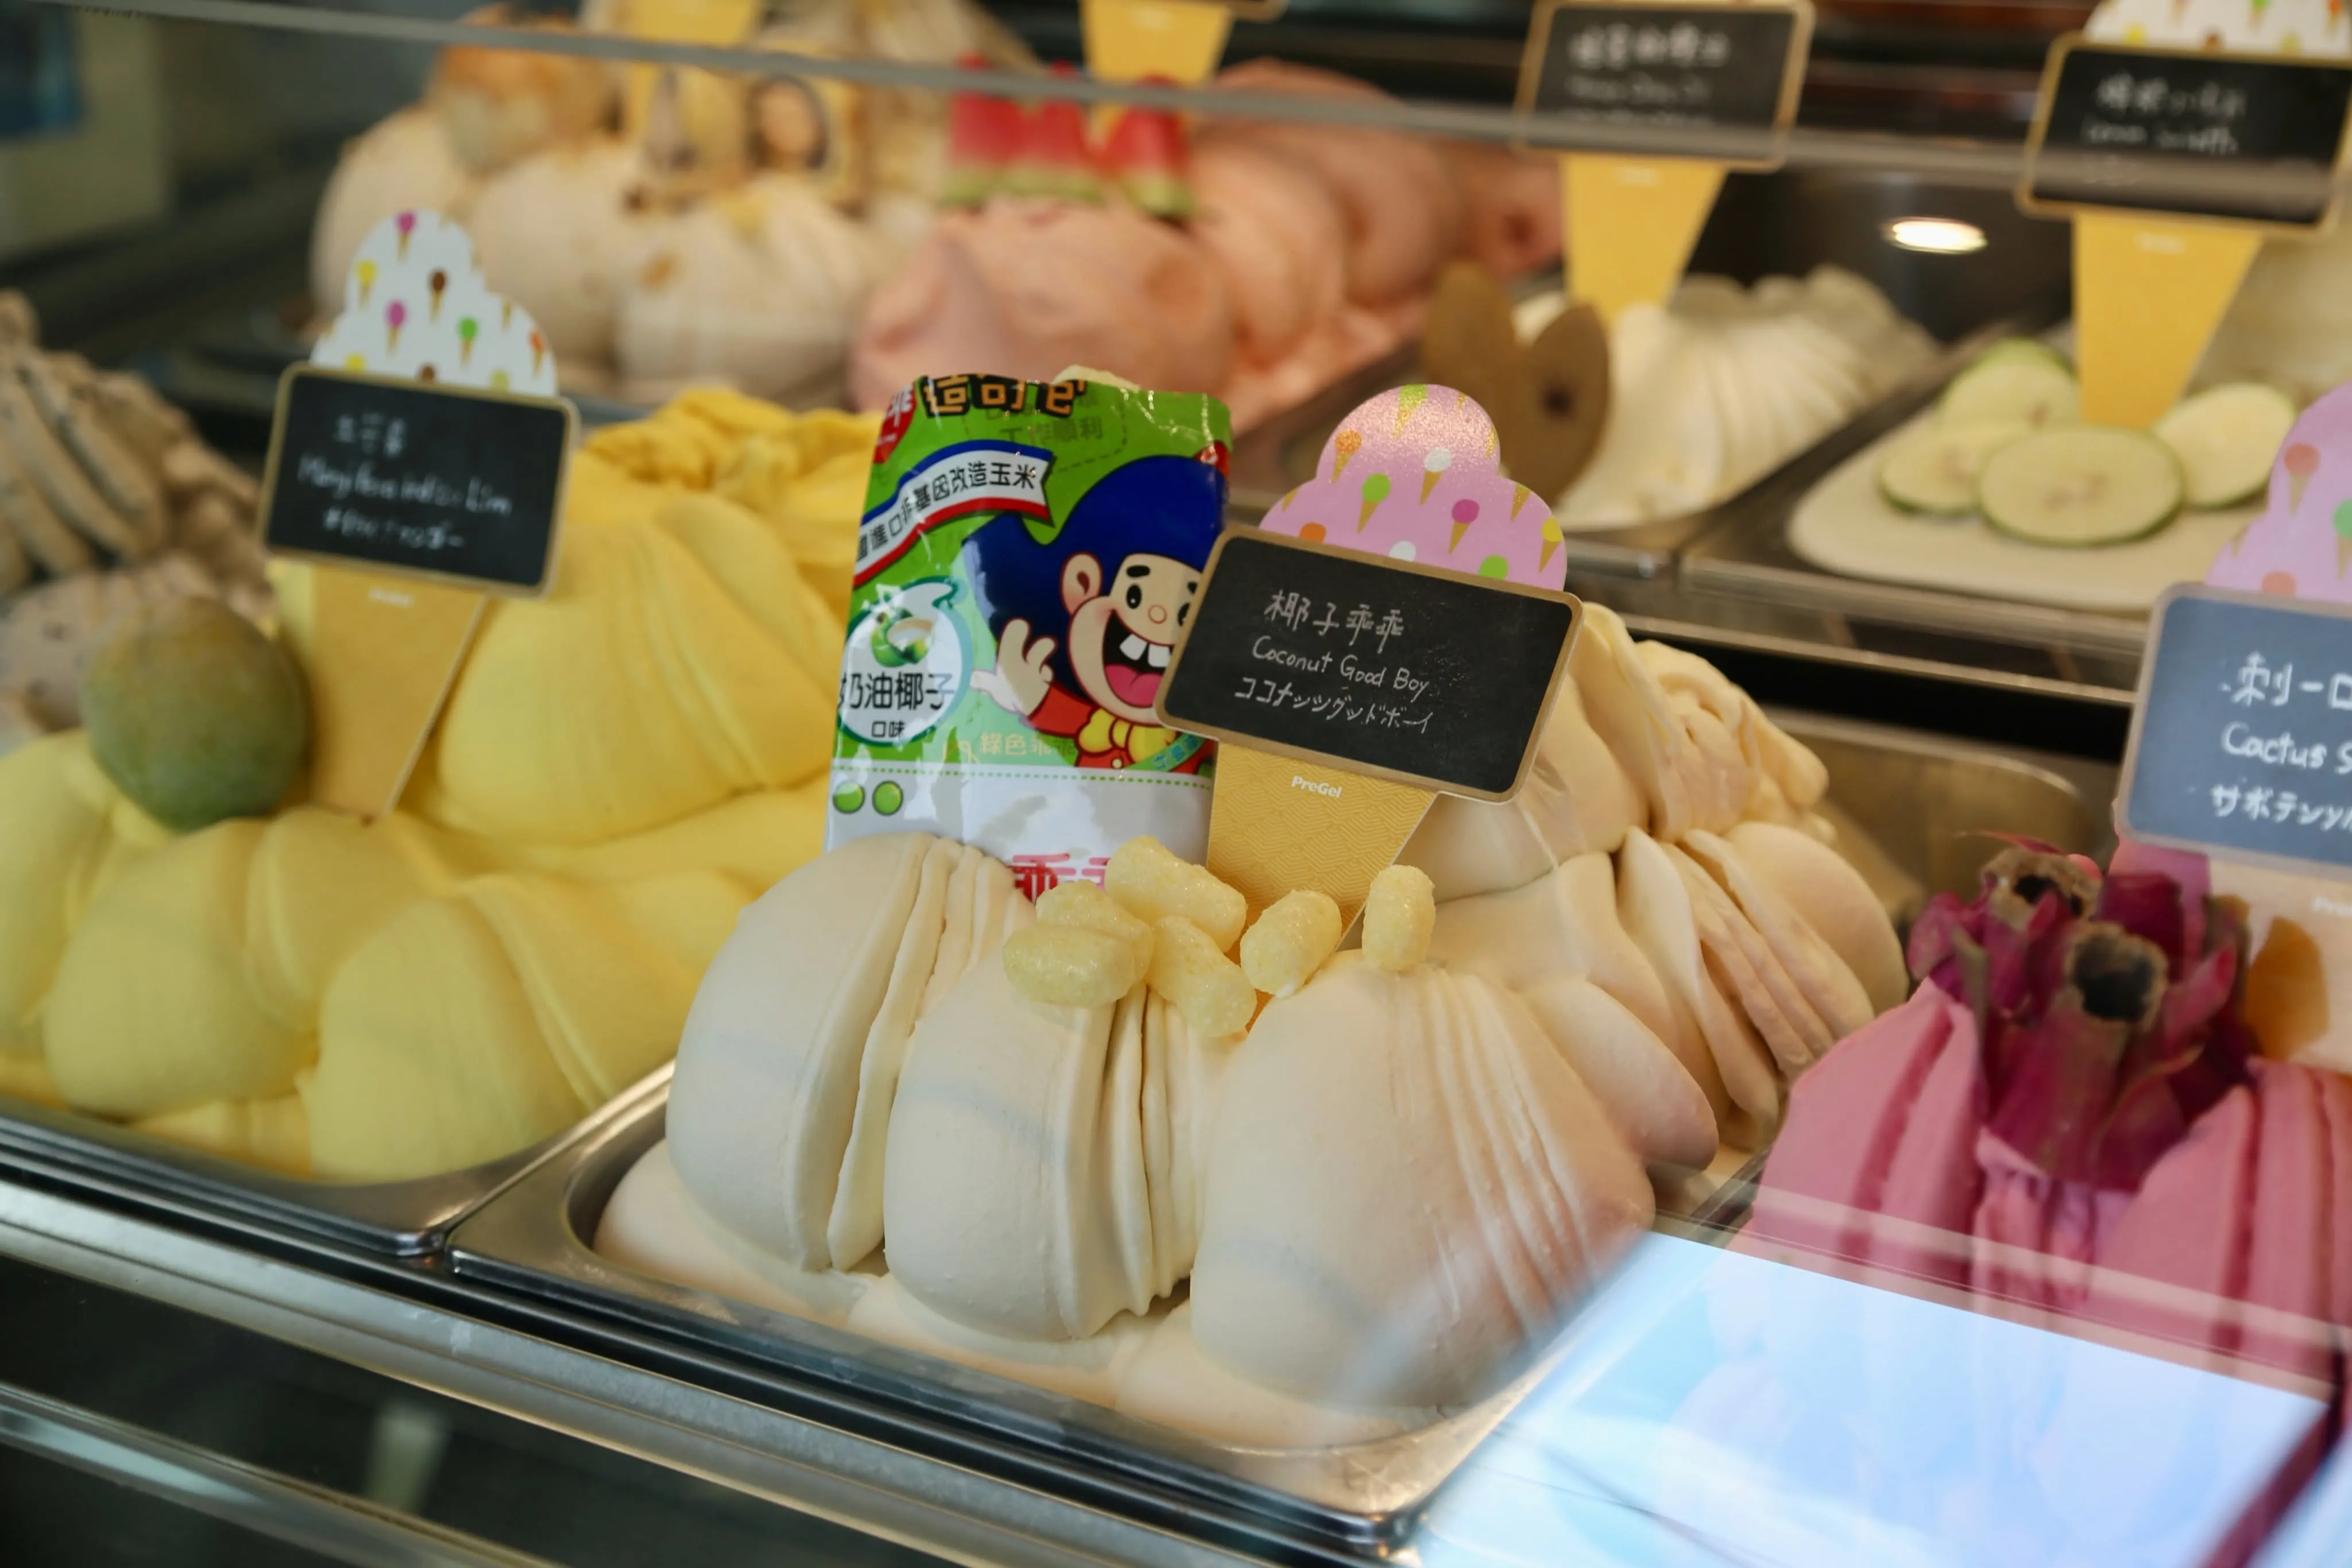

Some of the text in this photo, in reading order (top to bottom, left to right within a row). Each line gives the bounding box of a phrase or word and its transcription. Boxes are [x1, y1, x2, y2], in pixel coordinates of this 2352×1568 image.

[1264, 589, 1405, 654] 椰子乖乖
[1252, 635, 1430, 703] Coconut Good Boy
[2220, 721, 2328, 769] Cactus
[1291, 775, 1343, 798] PreGel
